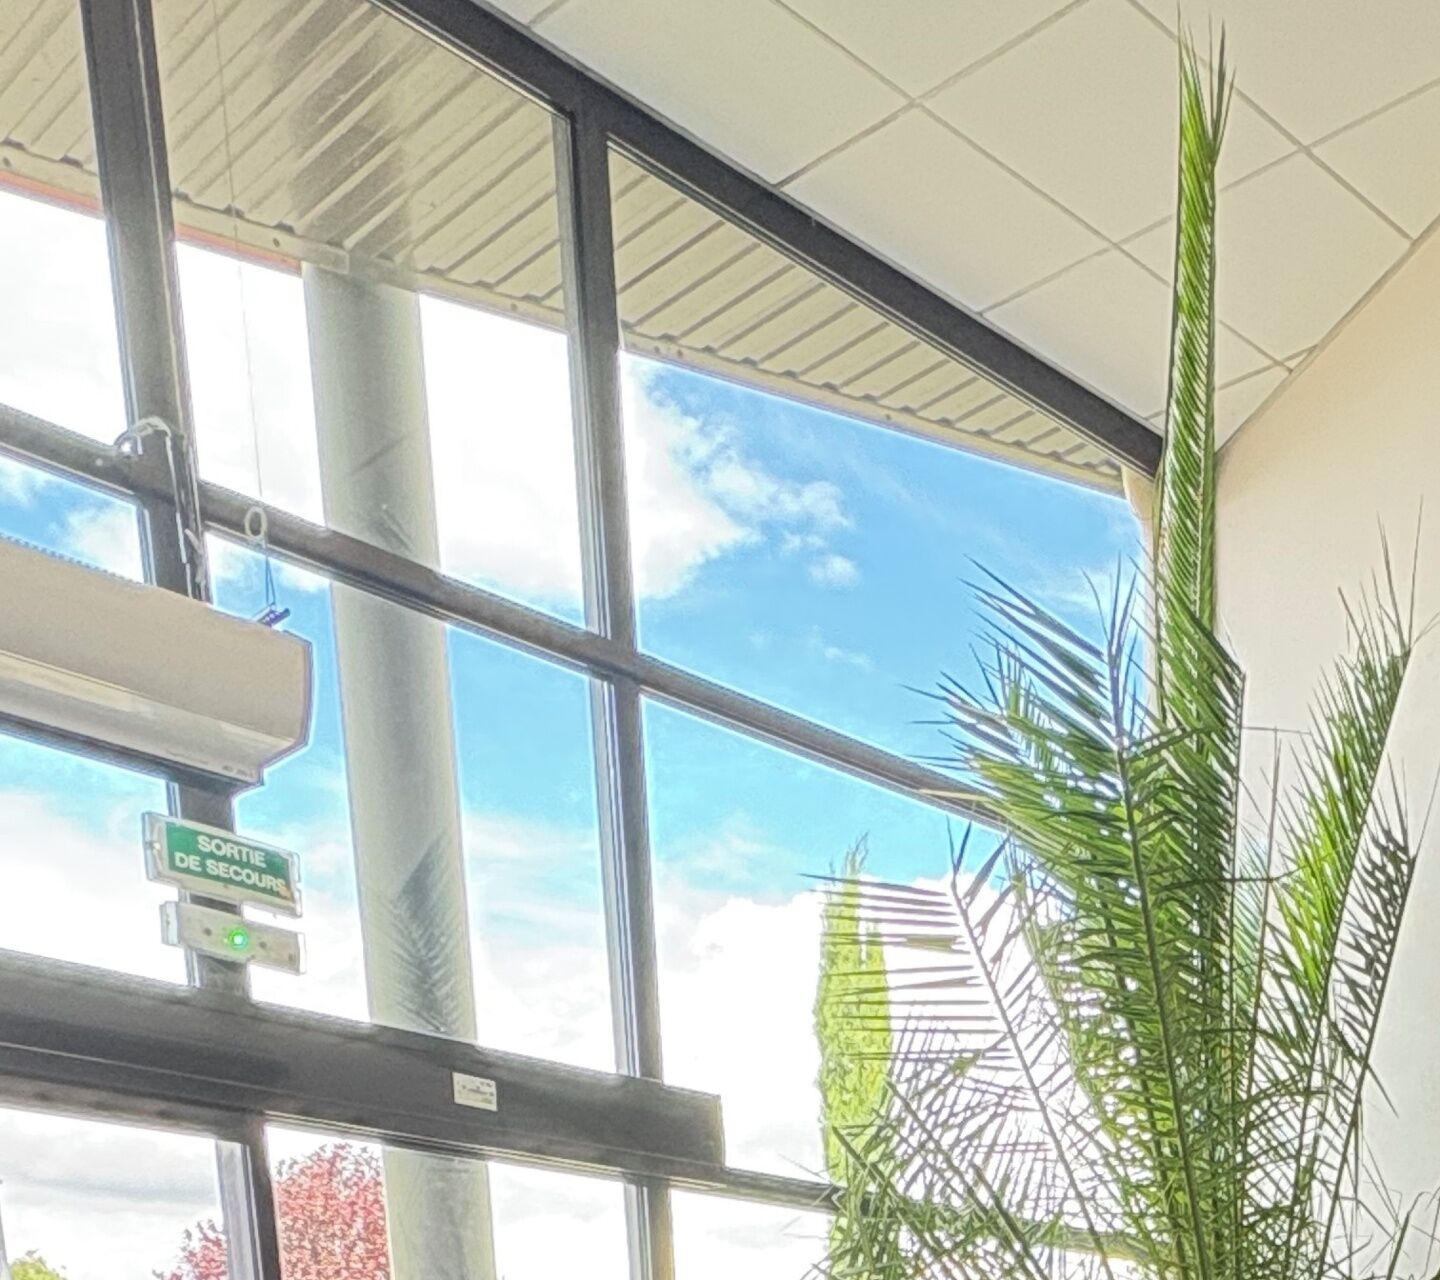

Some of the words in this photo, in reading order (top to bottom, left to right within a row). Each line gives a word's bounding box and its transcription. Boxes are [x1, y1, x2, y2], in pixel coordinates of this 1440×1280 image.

[197, 835, 266, 868] SORTIE
[174, 852, 202, 872] DE
[206, 859, 287, 891] SECOURS
